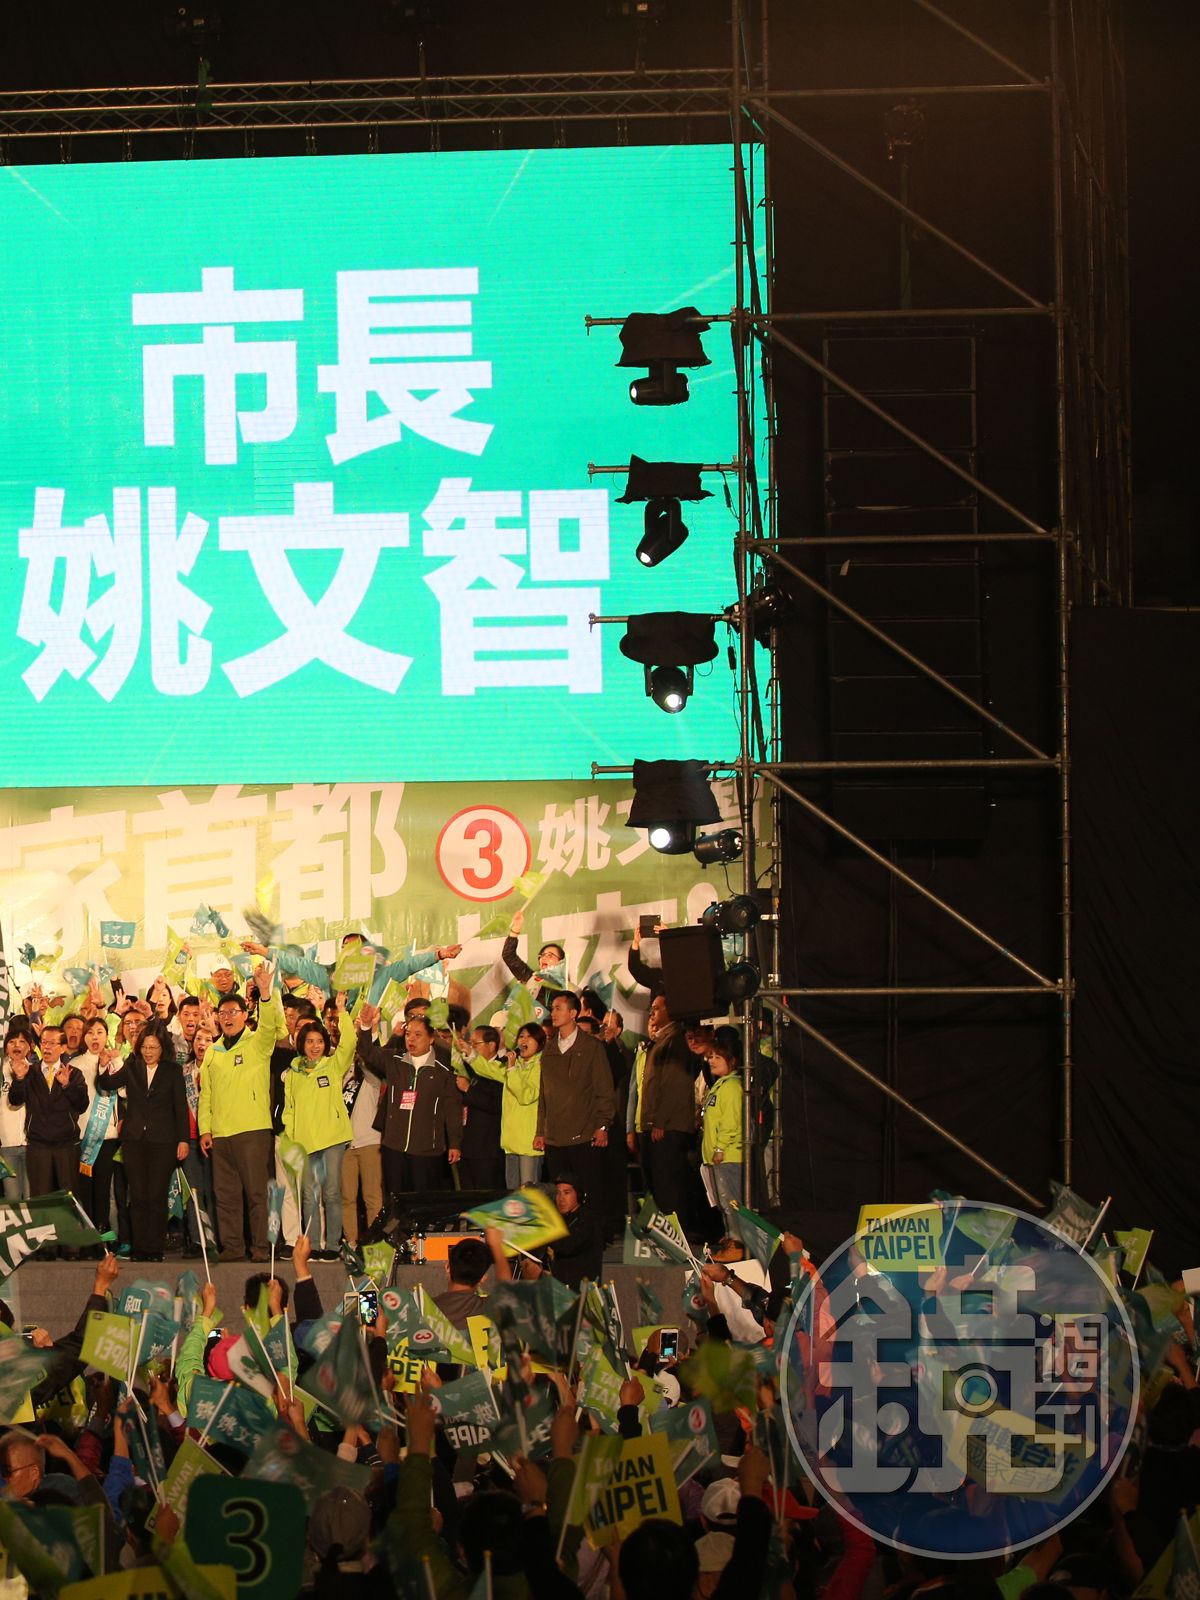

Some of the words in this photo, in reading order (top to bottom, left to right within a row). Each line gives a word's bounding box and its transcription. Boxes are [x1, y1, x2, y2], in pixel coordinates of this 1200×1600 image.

[132, 266, 495, 466] 市長
[16, 477, 611, 704] 姚文智
[462, 818, 504, 890] 3
[861, 1235, 936, 1261] TAIPEI
[865, 1217, 930, 1234] TAIWAN
[221, 1496, 272, 1588] 3
